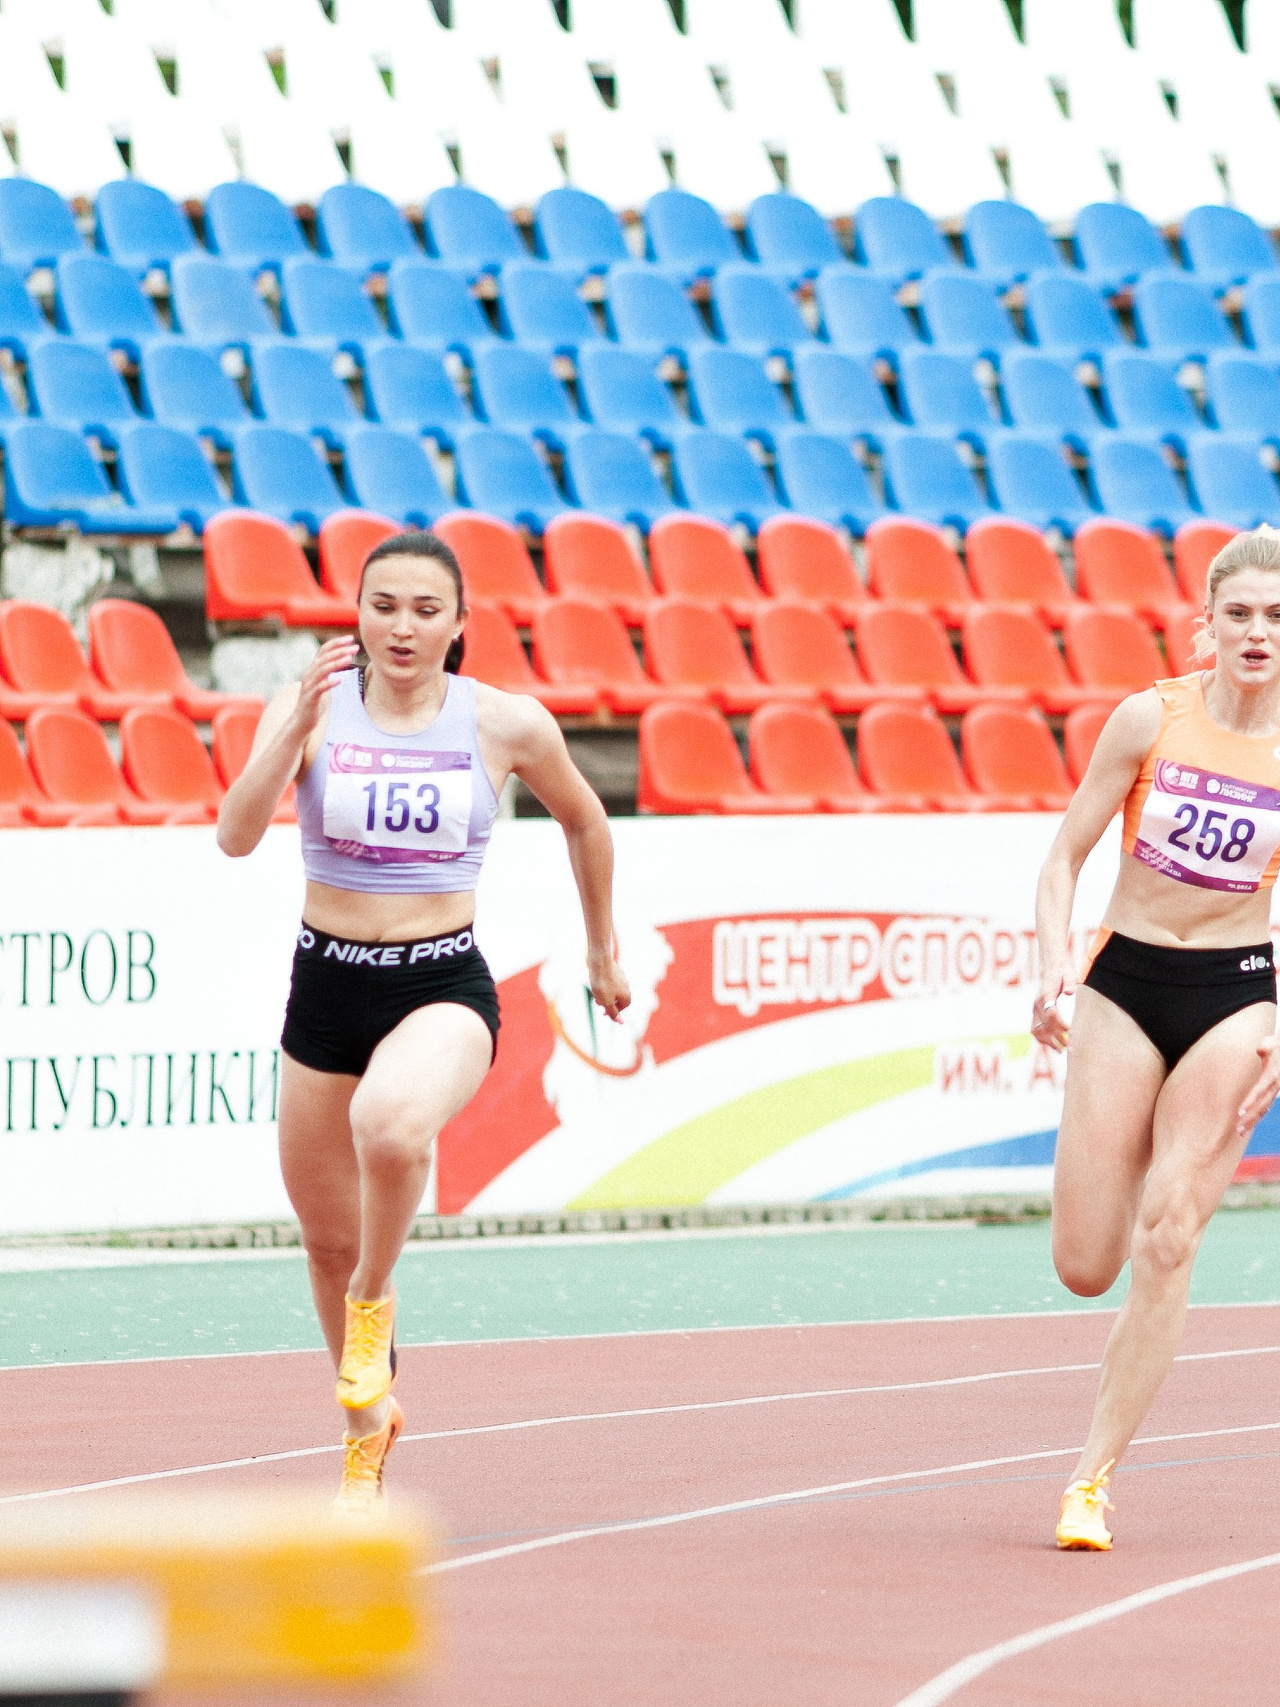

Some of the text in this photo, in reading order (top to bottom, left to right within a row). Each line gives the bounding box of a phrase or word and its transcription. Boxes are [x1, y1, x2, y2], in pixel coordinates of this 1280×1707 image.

[363, 781, 440, 834] 153
[1167, 803, 1255, 863] 258
[0, 929, 157, 1006] ТРОВ
[323, 940, 406, 967] NIKE
[408, 931, 473, 965] PRO
[721, 932, 873, 1000] ЦЕНТР
[1240, 955, 1270, 971] clo.
